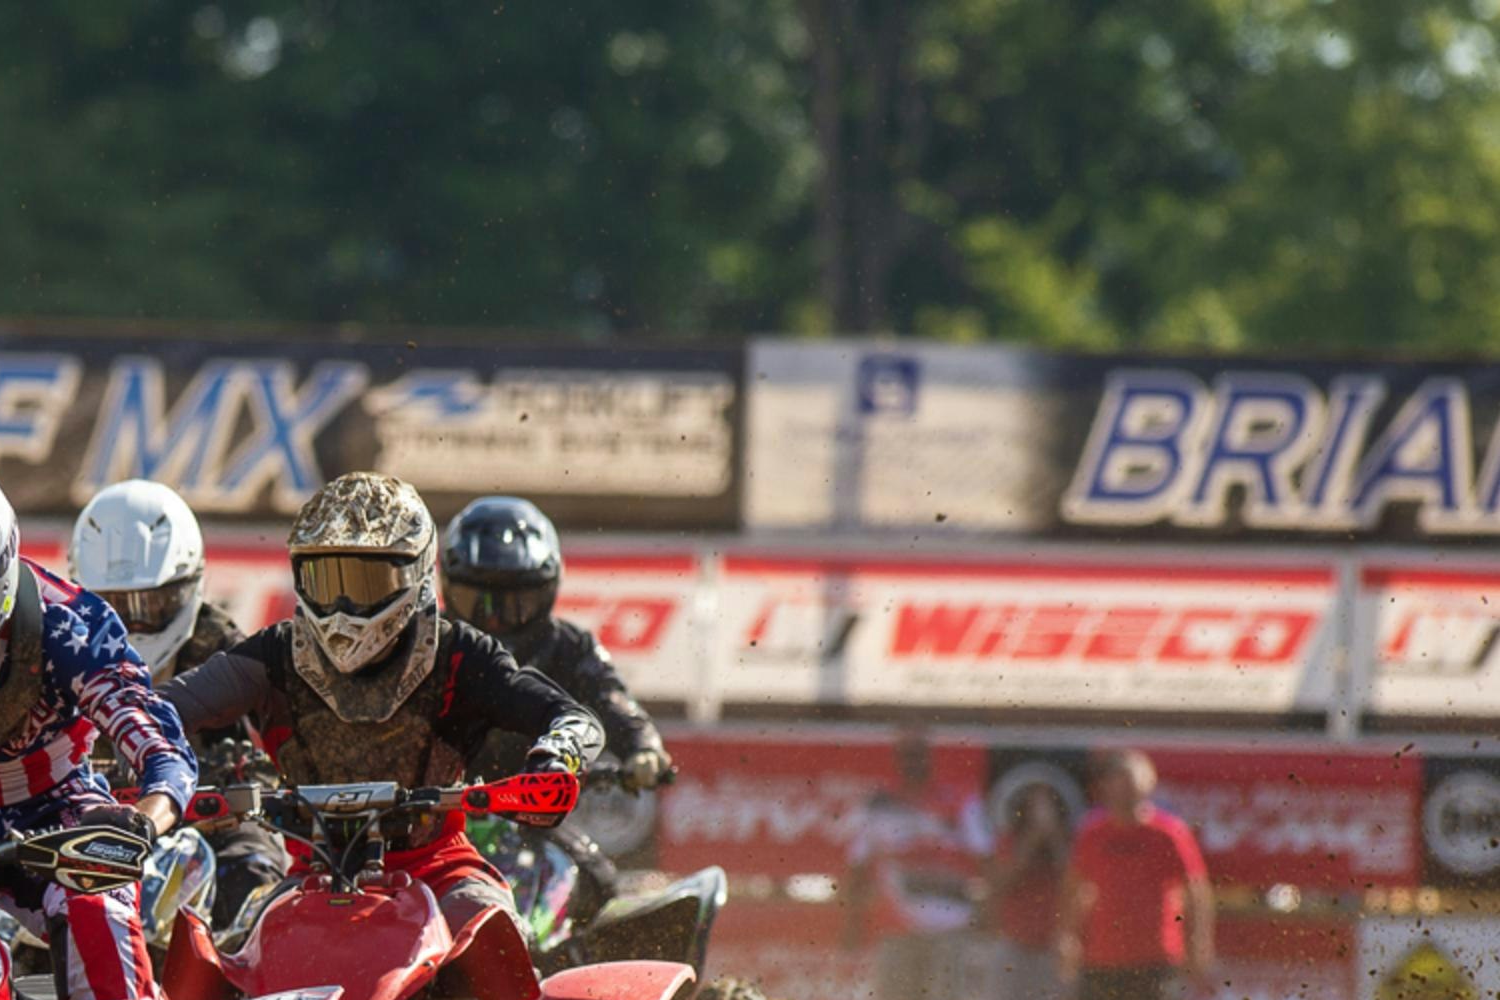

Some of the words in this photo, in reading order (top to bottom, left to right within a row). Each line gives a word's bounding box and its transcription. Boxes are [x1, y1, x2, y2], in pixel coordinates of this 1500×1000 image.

[74, 354, 370, 508] MX
[1061, 368, 1500, 532] BRIA
[887, 605, 1323, 664] WISECO
